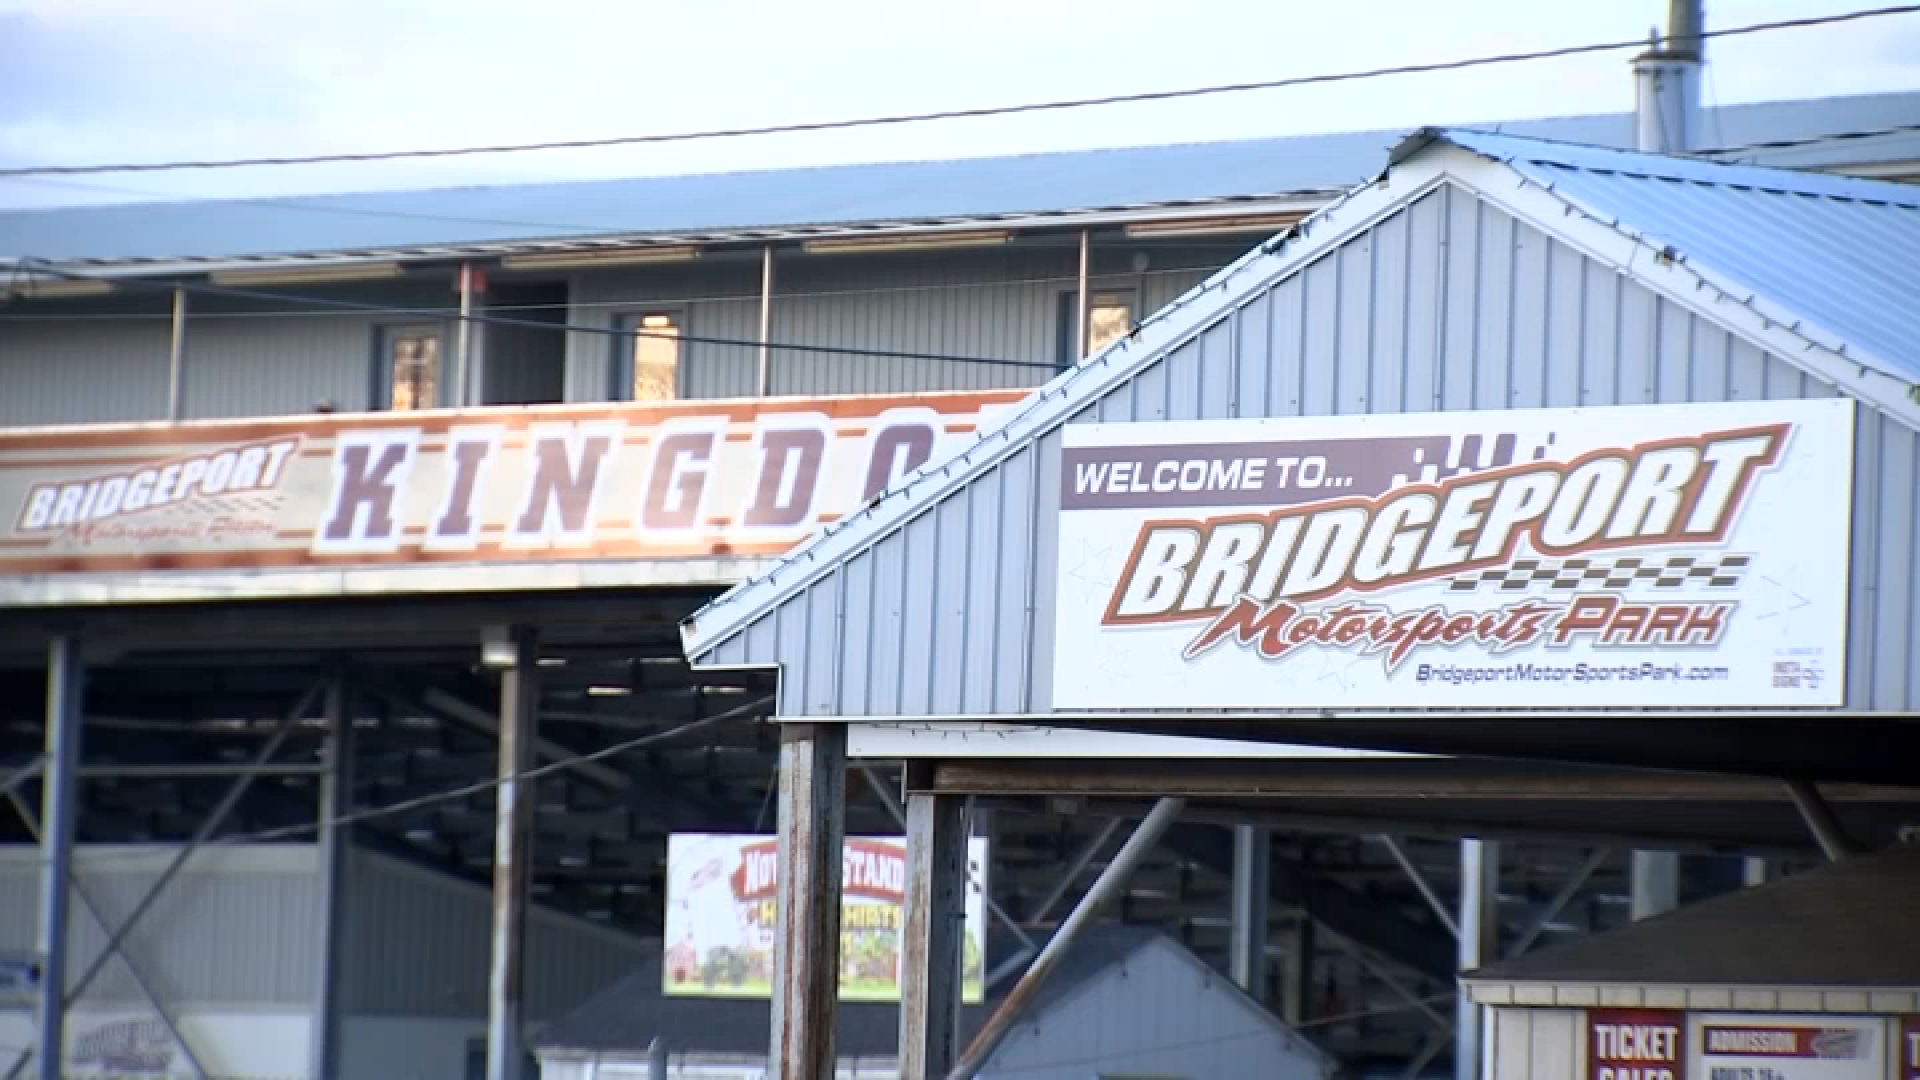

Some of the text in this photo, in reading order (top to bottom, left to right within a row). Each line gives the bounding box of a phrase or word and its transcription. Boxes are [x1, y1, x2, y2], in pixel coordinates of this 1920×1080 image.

[20, 439, 296, 530] BRIDGEPORT
[321, 416, 938, 545] KINGDO
[1074, 455, 1354, 494] WELCOME TO...
[1108, 428, 1782, 620] BRIDGEPORT
[1185, 597, 1564, 666] Motorsports
[1415, 661, 1730, 685] BridgeportMotorSportsPark.com
[1594, 1023, 1679, 1061] TICKET
[1707, 1030, 1797, 1053] ADMISSION
